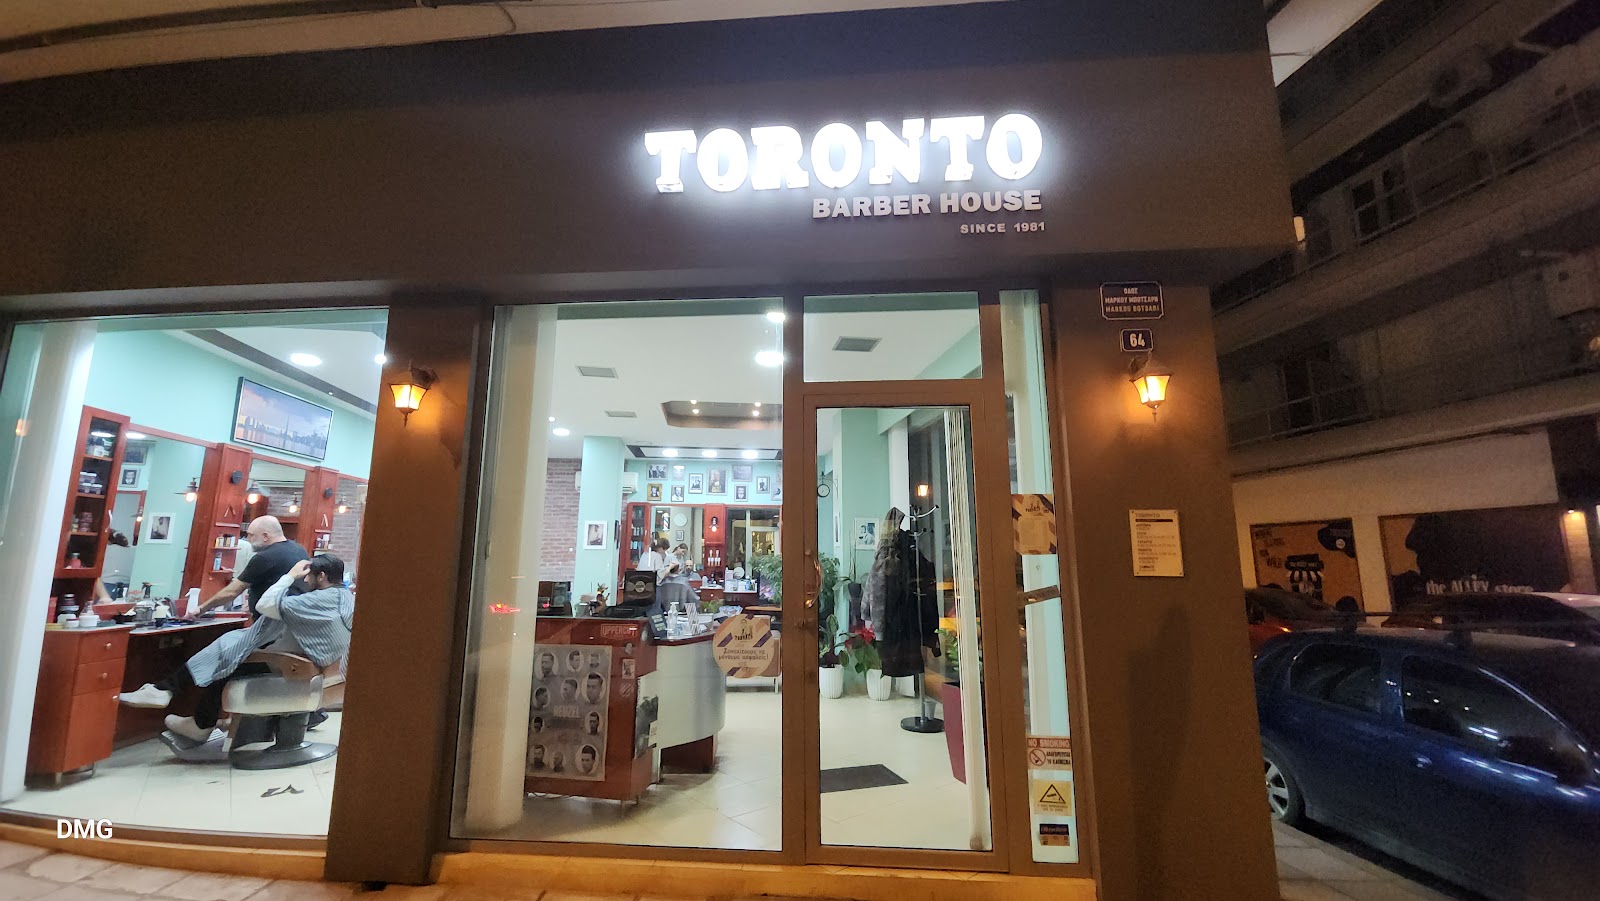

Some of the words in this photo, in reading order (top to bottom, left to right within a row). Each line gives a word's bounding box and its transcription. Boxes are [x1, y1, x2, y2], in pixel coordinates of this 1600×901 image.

[643, 112, 1043, 193] TORONTO
[812, 193, 931, 219] BARBER
[939, 189, 1042, 214] HOUSE
[960, 222, 1006, 235] SINCE
[1013, 221, 1046, 233] 1981
[1129, 332, 1146, 348] 64
[1426, 579, 1447, 595] the
[1028, 738, 1038, 748] NO
[1039, 738, 1070, 748] SMOKING
